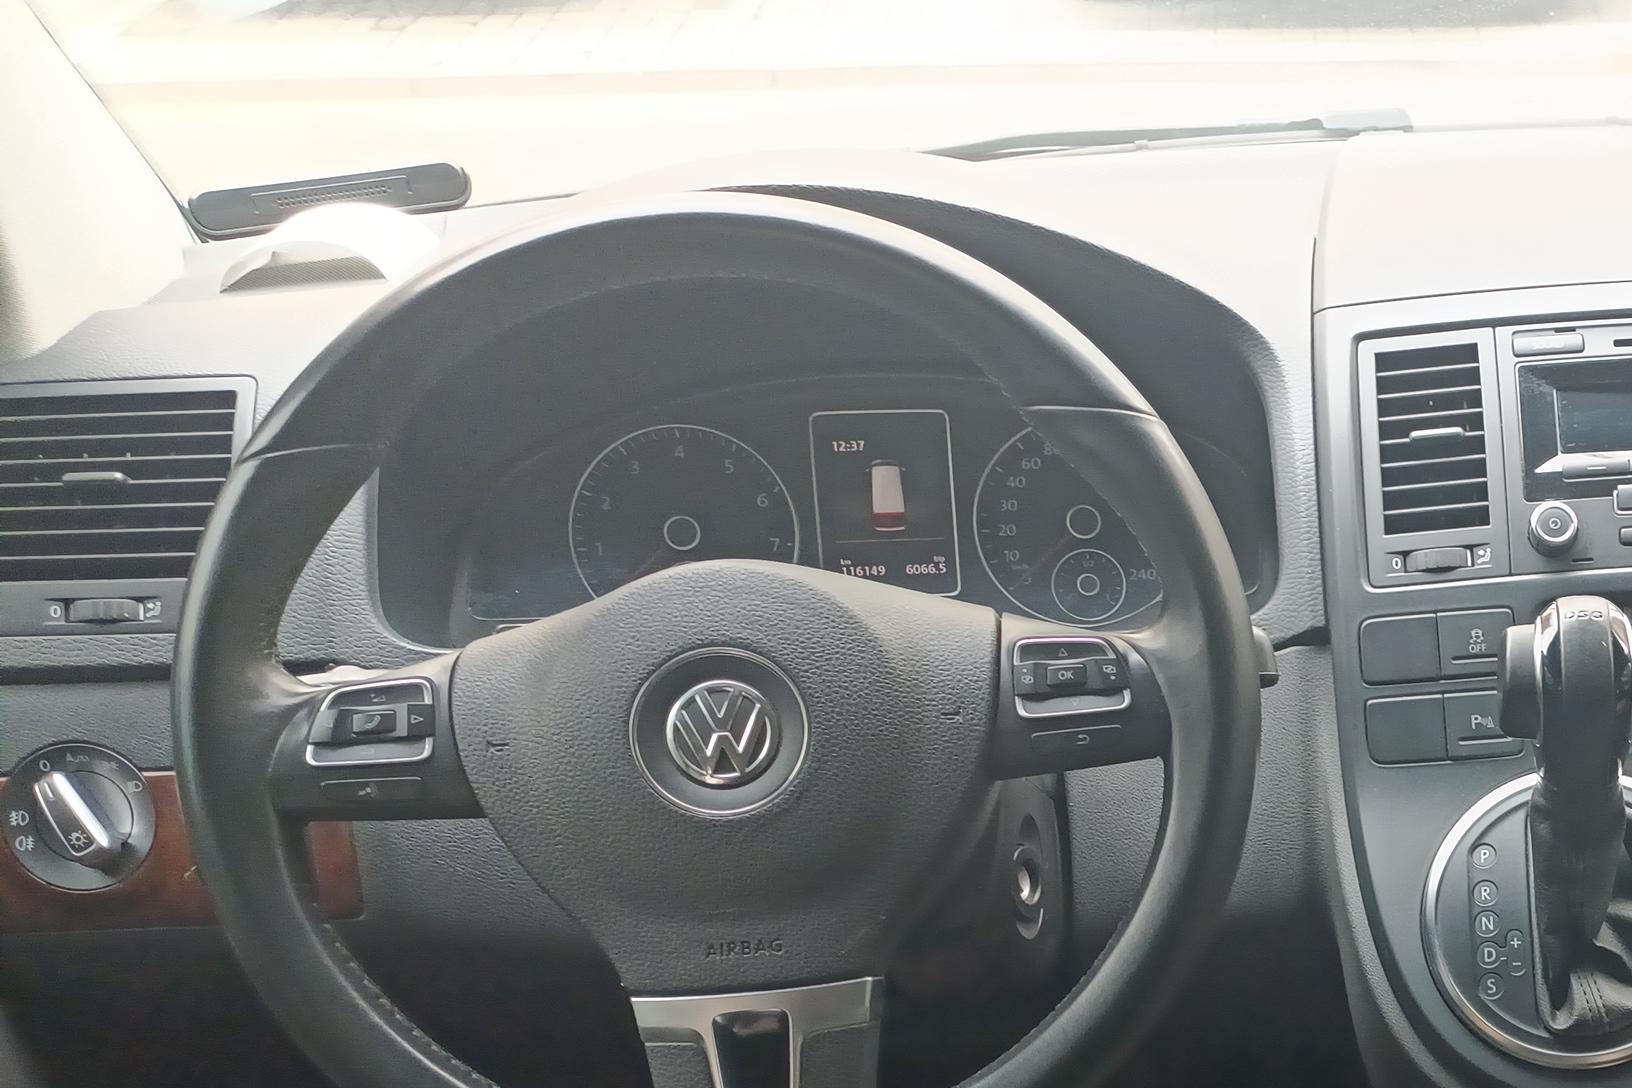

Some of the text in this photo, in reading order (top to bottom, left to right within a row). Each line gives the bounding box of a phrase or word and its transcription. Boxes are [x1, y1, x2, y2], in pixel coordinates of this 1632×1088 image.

[675, 445, 684, 459] 4
[832, 440, 865, 452] 12:37
[631, 461, 640, 474] 3
[725, 459, 735, 474] 5
[1021, 457, 1041, 470] 60
[1006, 476, 1026, 488] 40
[757, 493, 769, 507] 6
[1000, 499, 1018, 512] 30
[998, 524, 1017, 536] 20
[770, 538, 780, 551] 7
[842, 566, 886, 577] 116149
[905, 563, 947, 575] 6066.5
[1130, 569, 1156, 580] 240
[1564, 610, 1604, 621] DSG
[1469, 644, 1487, 653] OFF
[1058, 670, 1075, 680] OK
[1480, 850, 1490, 863] P
[1481, 886, 1491, 900] R
[1481, 917, 1494, 931] N
[704, 939, 785, 960] AIRBAG
[1484, 948, 1496, 962] D
[1487, 979, 1497, 993] S
